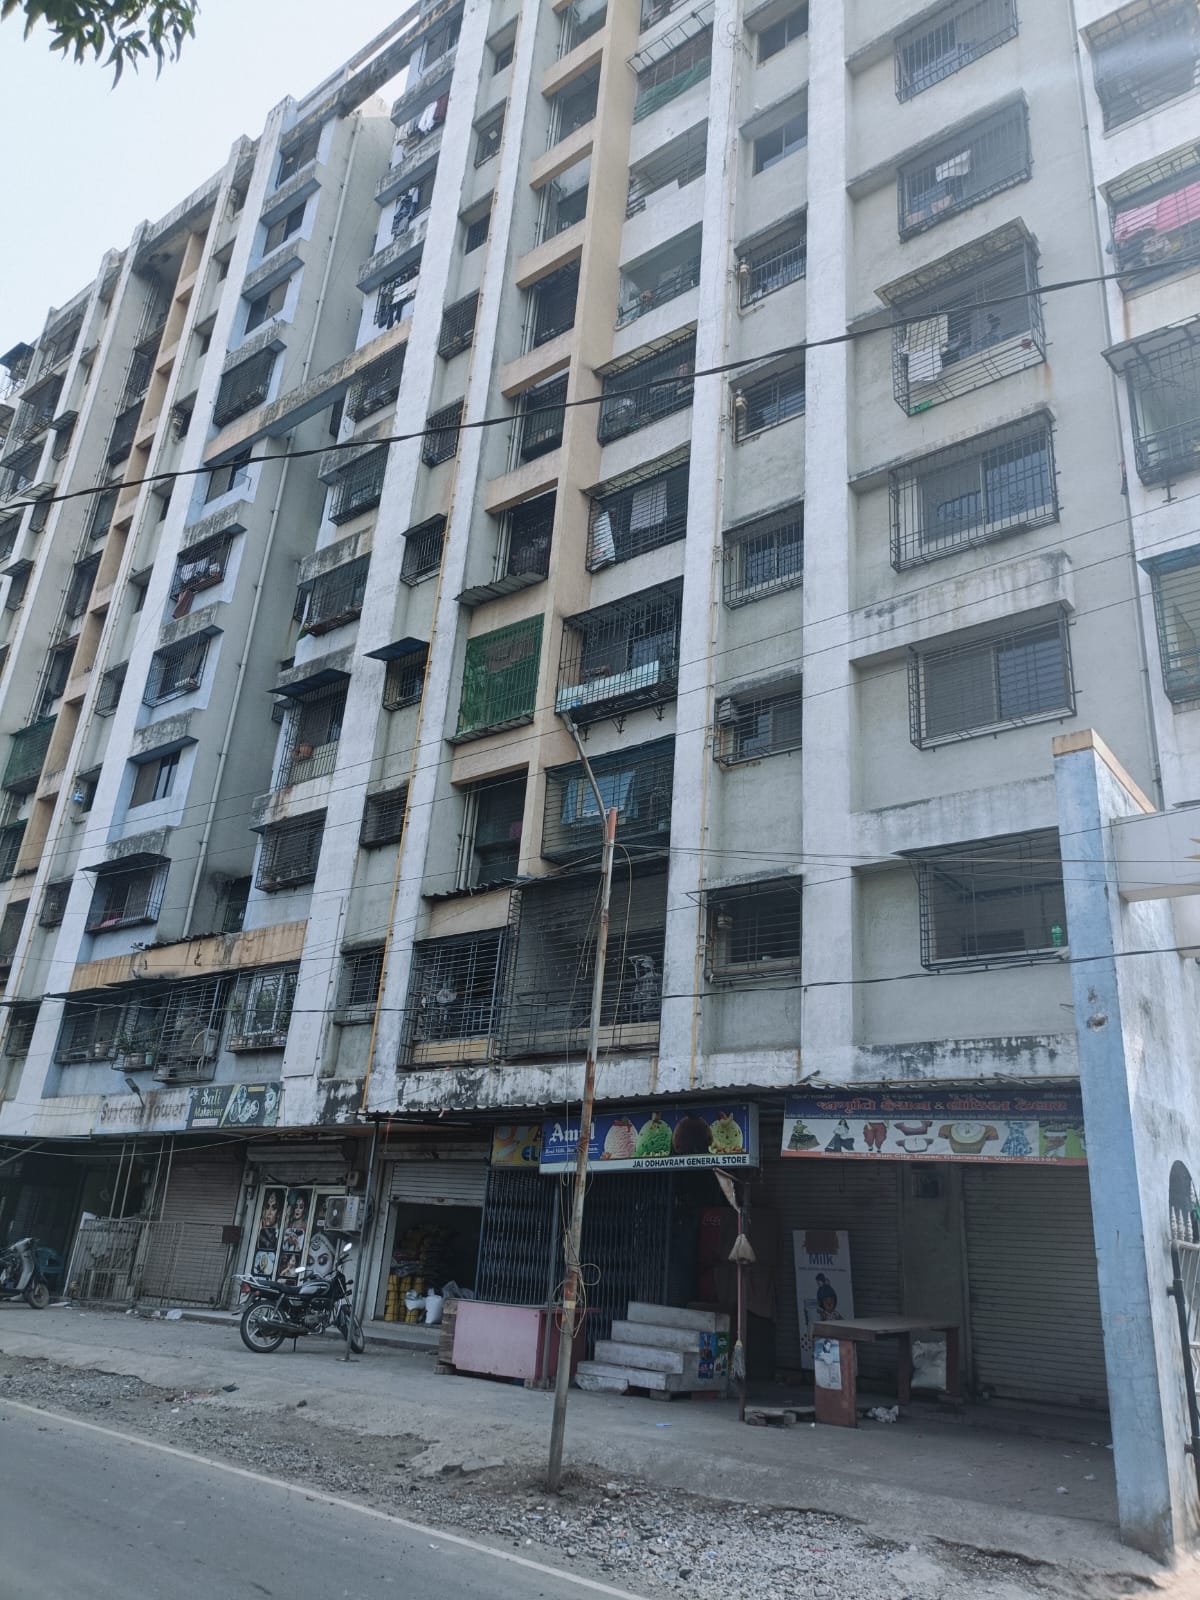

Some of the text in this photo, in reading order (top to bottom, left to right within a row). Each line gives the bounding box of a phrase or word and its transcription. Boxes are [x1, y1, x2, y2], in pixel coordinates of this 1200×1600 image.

[934, 1101, 945, 1110] &
[632, 1156, 747, 1168] JAI ODHAVRAM GENERAL STORE
[808, 1252, 833, 1265] Milk
